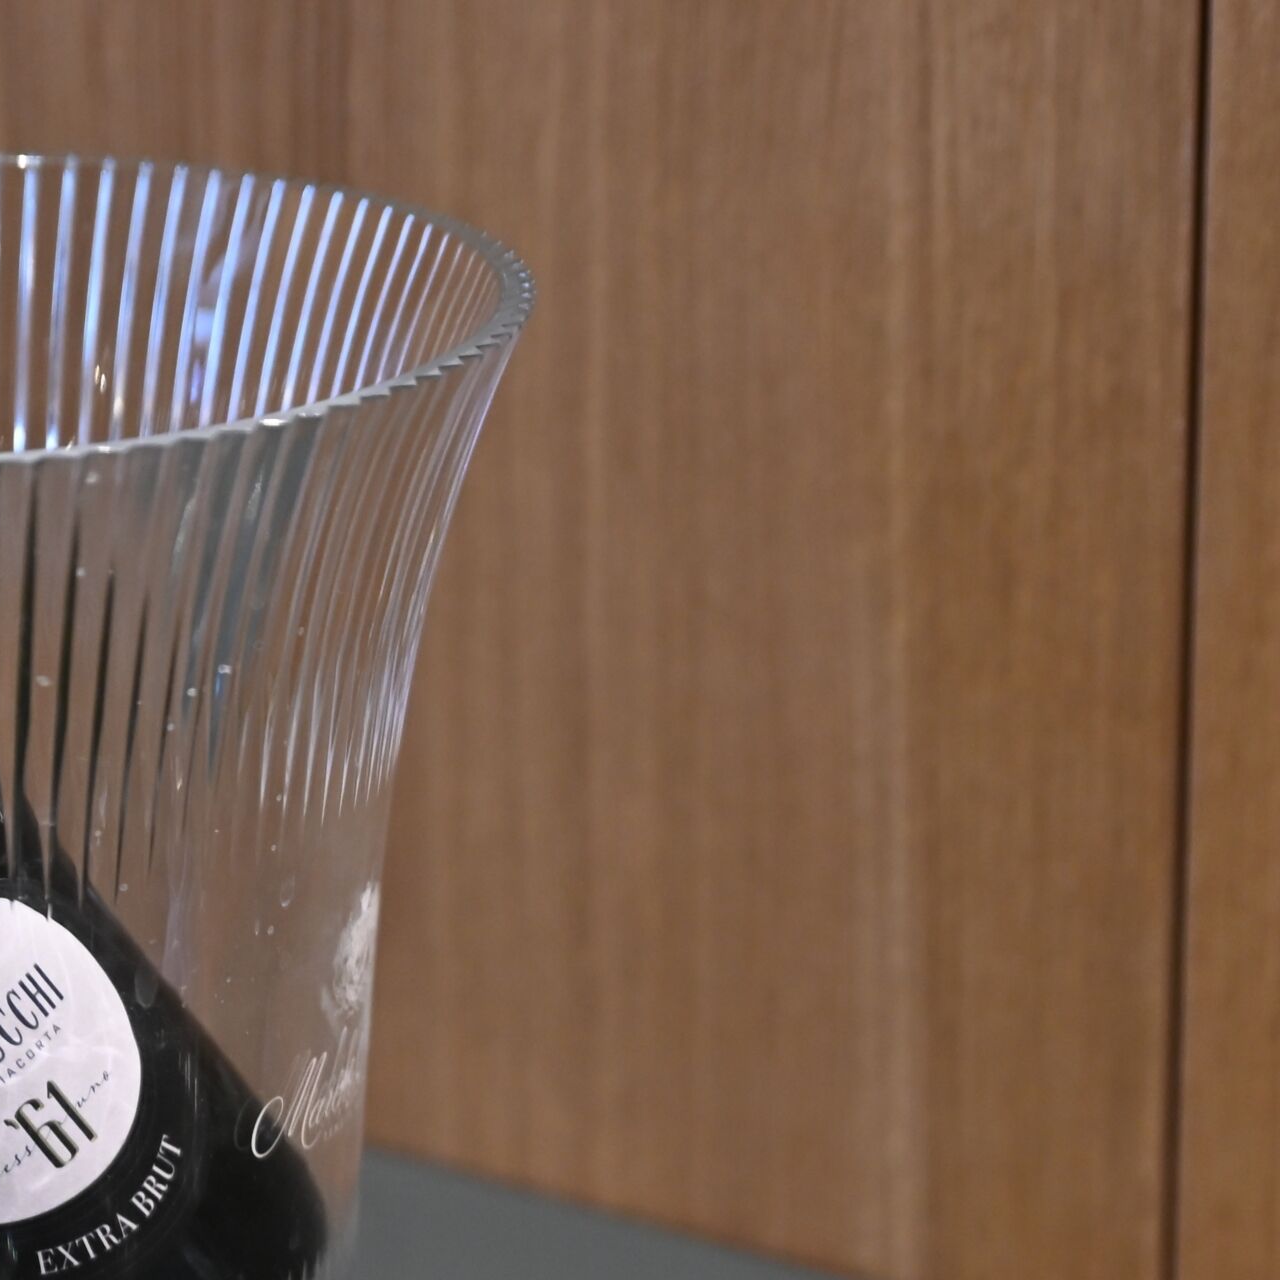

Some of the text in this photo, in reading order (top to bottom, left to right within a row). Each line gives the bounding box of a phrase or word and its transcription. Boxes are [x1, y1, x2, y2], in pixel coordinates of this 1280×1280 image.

[3, 1079, 98, 1169] '61
[36, 1133, 184, 1276] EXTRA BRUT
